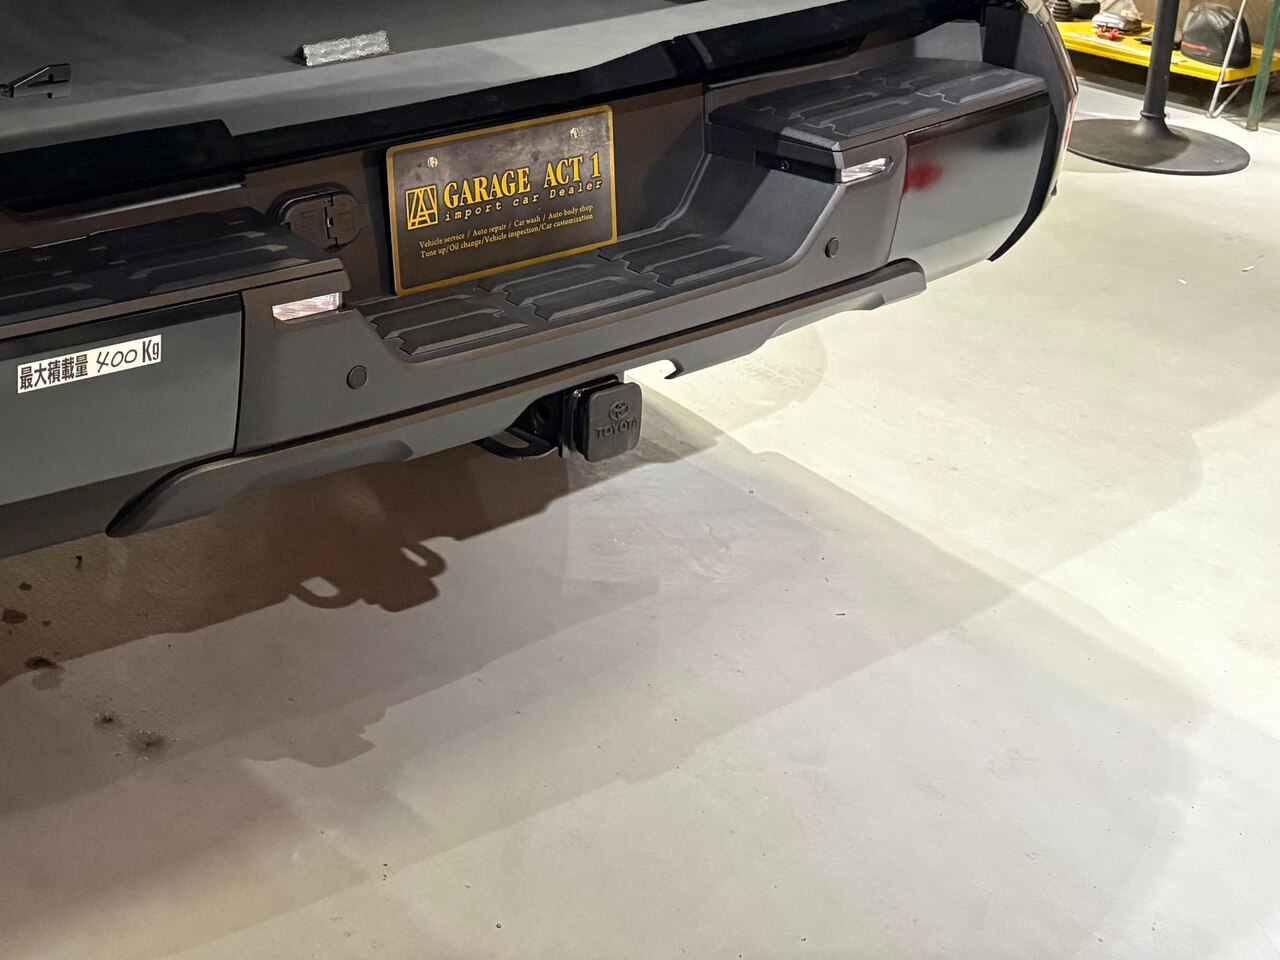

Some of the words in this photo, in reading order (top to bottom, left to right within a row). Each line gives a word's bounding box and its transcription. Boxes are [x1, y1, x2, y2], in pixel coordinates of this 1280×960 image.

[443, 167, 531, 209] GARAGE
[543, 155, 583, 189] ACT
[590, 152, 601, 178] 1
[445, 200, 502, 221] import
[512, 194, 539, 207] car
[549, 179, 602, 199] Dealer
[419, 237, 442, 249] Vehicle
[444, 234, 465, 244] service
[472, 228, 487, 237] Auto
[489, 223, 506, 234] repair
[514, 219, 525, 228] Car
[526, 215, 541, 225] wash
[548, 211, 563, 220] Auto
[564, 206, 578, 216] body
[579, 203, 593, 213] shop
[420, 250, 437, 259] Tune
[553, 214, 594, 228] customization
[20, 353, 89, 391] 最大積載量
[96, 348, 138, 373] 400
[142, 339, 160, 363] Kg
[594, 416, 639, 439] TOYOTA
